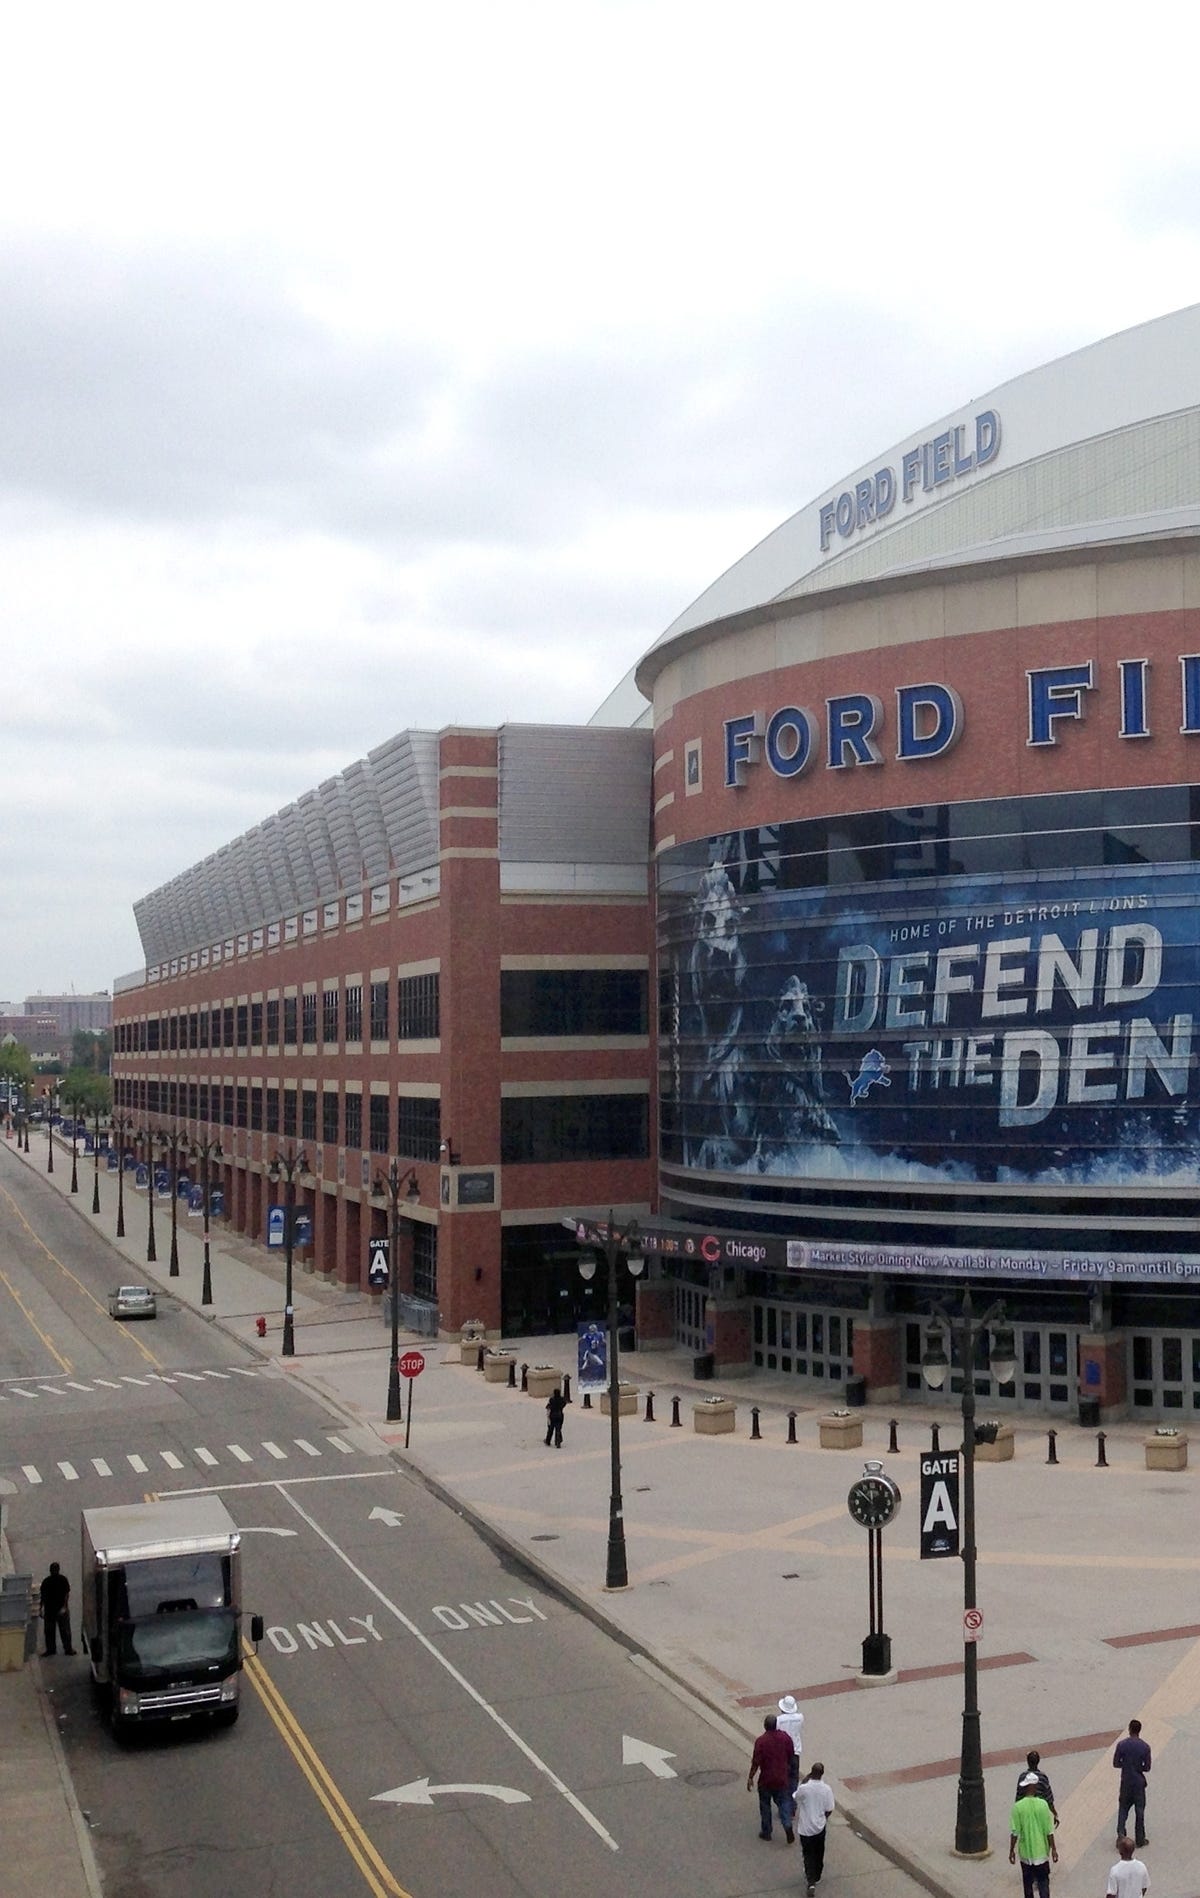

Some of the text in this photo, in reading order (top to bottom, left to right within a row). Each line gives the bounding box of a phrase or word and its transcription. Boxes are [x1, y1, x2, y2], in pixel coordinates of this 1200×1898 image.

[819, 409, 1001, 551] FORD FIELD
[723, 681, 964, 788] FORD
[890, 923, 930, 942] HOME
[938, 919, 957, 934] OF
[966, 914, 995, 931] THE
[1004, 902, 1080, 926] DETROIT
[832, 922, 1163, 1034] DEFEND
[903, 1014, 1195, 1127] THE DEN
[370, 1239, 389, 1248] GATE
[370, 1250, 389, 1274] A
[726, 1241, 766, 1262] Chicago
[811, 1249, 846, 1263] Market
[848, 1252, 875, 1267] Style
[878, 1252, 911, 1269] Dining
[914, 1254, 938, 1266] Now
[942, 1255, 997, 1269] Available
[1000, 1257, 1047, 1273] Monday
[1063, 1259, 1103, 1275] Friday
[1108, 1260, 1136, 1273] 9am
[1140, 1260, 1171, 1274] until
[400, 1359, 424, 1370] STOP
[922, 1458, 957, 1476] GATE
[923, 1481, 957, 1532] A
[431, 1596, 549, 1632] ONLY
[266, 1614, 384, 1655] ONLY
